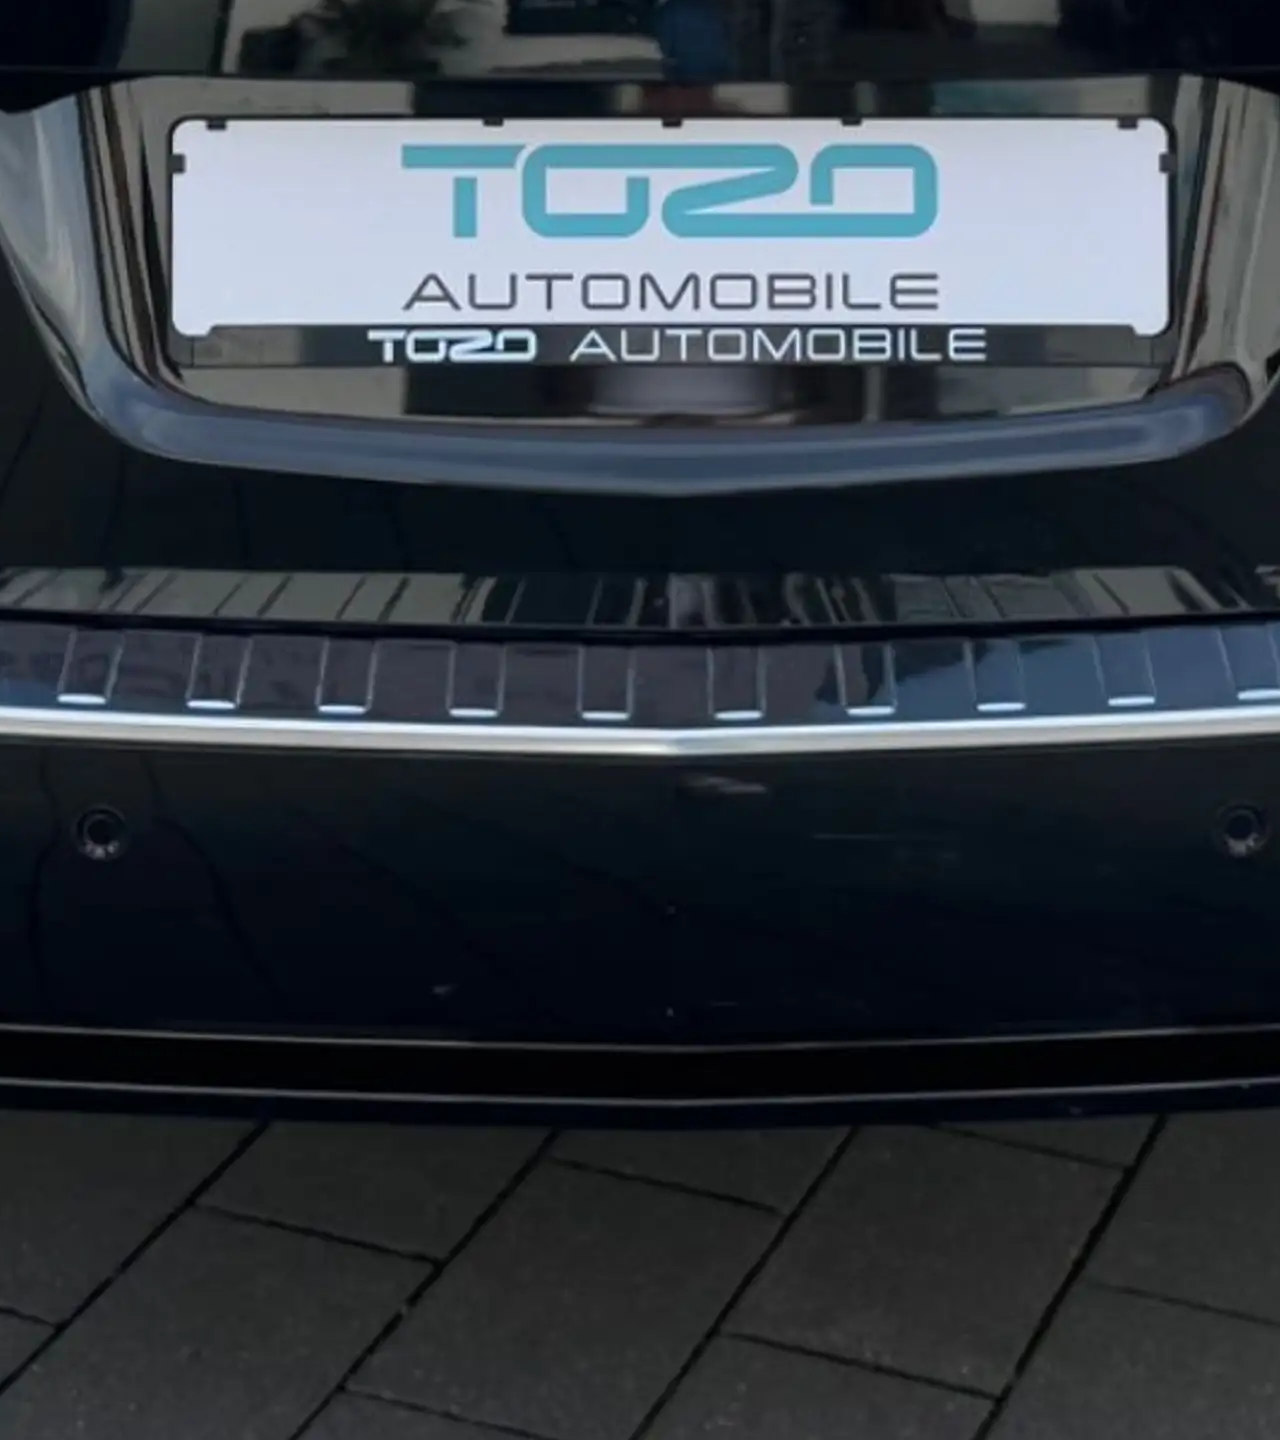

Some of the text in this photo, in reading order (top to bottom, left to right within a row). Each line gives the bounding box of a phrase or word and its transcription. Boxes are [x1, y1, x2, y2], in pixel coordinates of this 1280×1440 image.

[402, 144, 939, 238] TOZO
[402, 273, 939, 311] AUTOMOBILE
[367, 328, 987, 363] TOZO AUTOMOBILE
